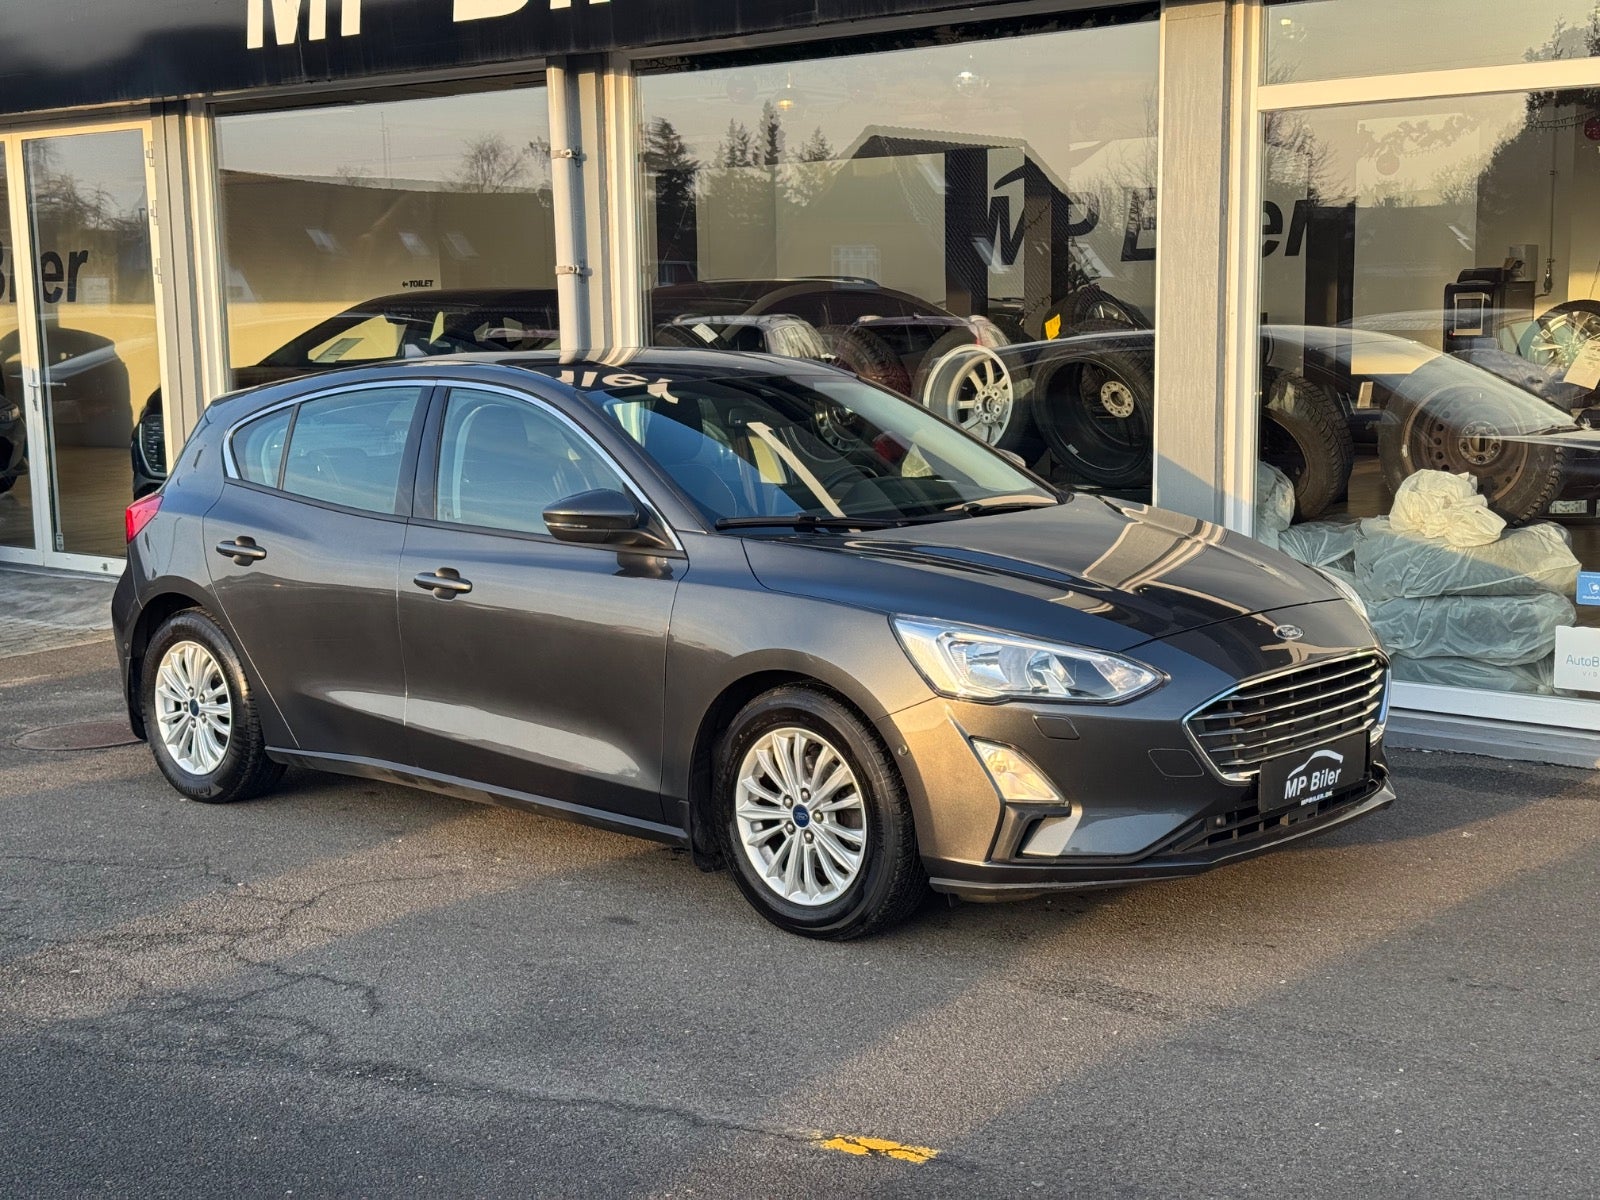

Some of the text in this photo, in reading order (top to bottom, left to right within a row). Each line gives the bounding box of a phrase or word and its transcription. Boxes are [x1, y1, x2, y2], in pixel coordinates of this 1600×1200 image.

[408, 279, 434, 288] TOILET
[1284, 768, 1342, 800] MP Biler
